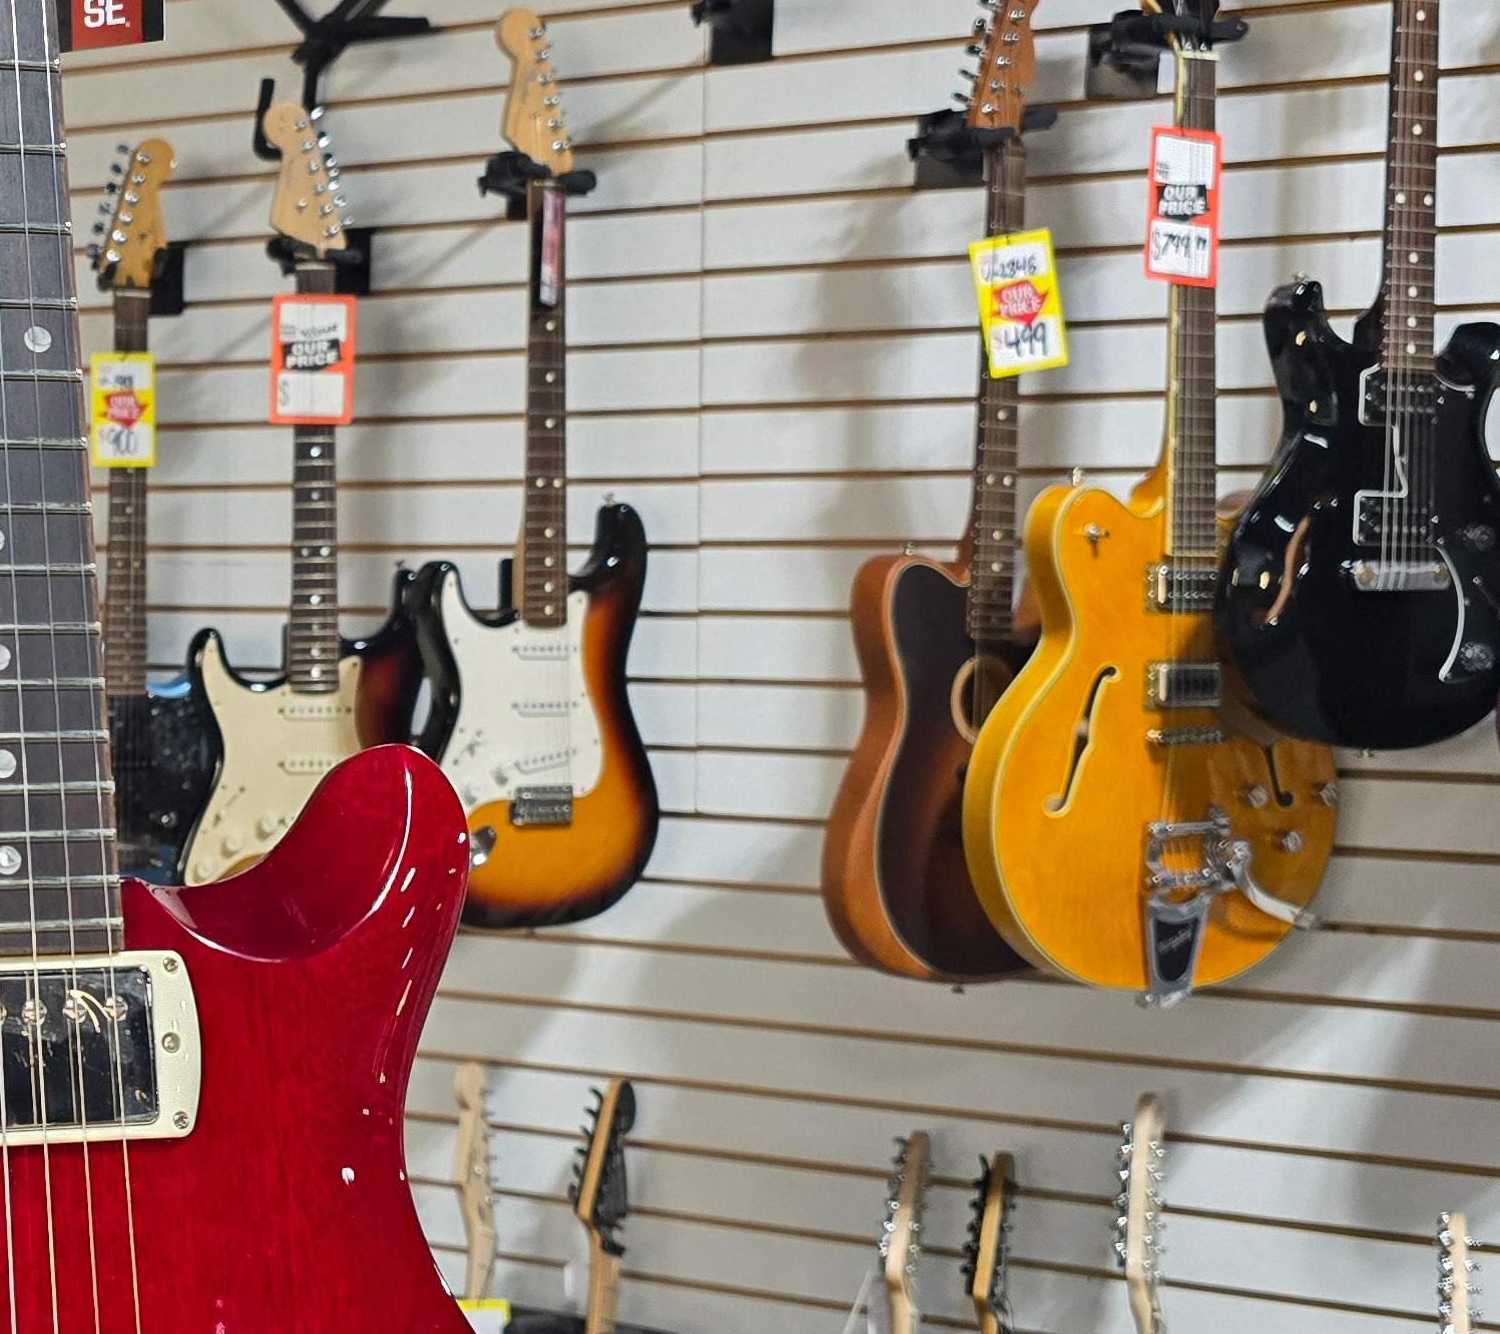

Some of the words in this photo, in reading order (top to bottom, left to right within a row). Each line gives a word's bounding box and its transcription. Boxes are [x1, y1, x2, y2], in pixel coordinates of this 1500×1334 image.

[1163, 184, 1199, 201] OUR
[1158, 198, 1207, 217] PRICE
[1001, 283, 1035, 302] OUR
[999, 298, 1042, 317] PRICE
[291, 342, 330, 356] OUR
[286, 352, 339, 369] PRICE
